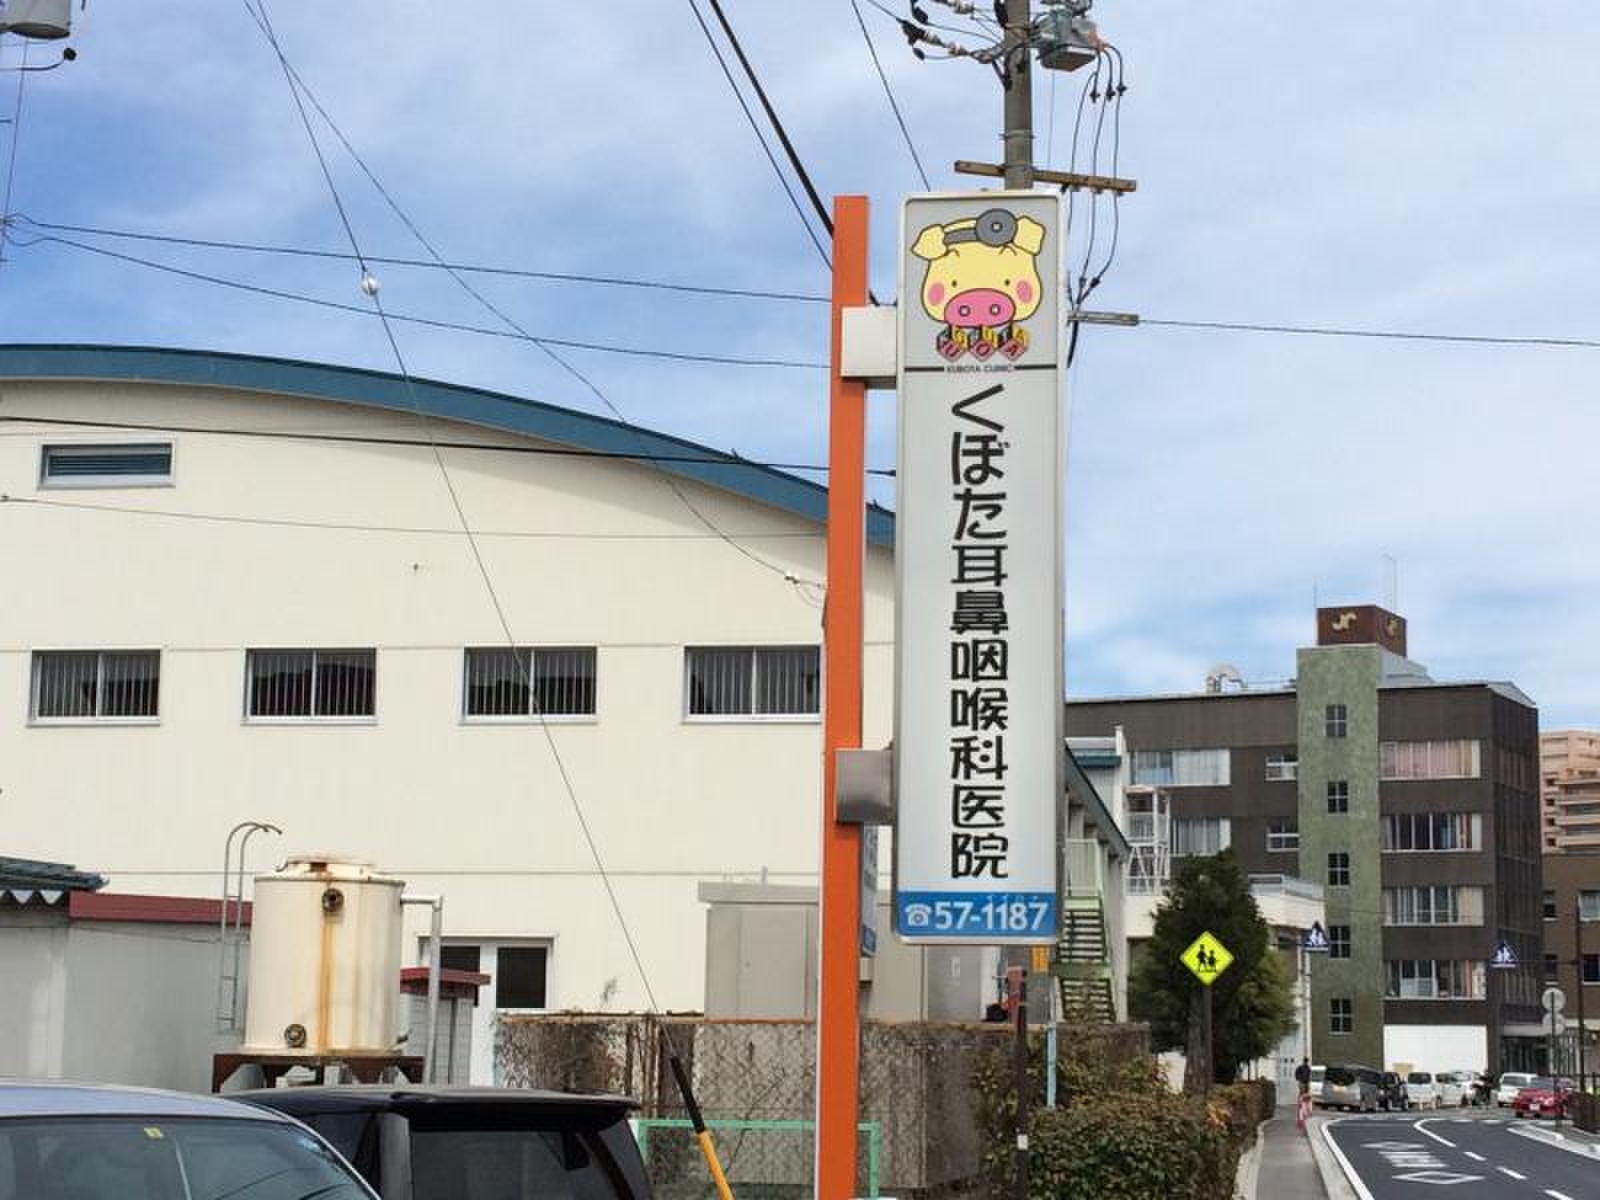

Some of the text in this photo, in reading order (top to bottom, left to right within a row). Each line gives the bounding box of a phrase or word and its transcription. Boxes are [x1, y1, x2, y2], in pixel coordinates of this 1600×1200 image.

[950, 383, 1010, 879] くぼた耳鼻咽喉科医院
[934, 901, 1049, 931] 57-1187
